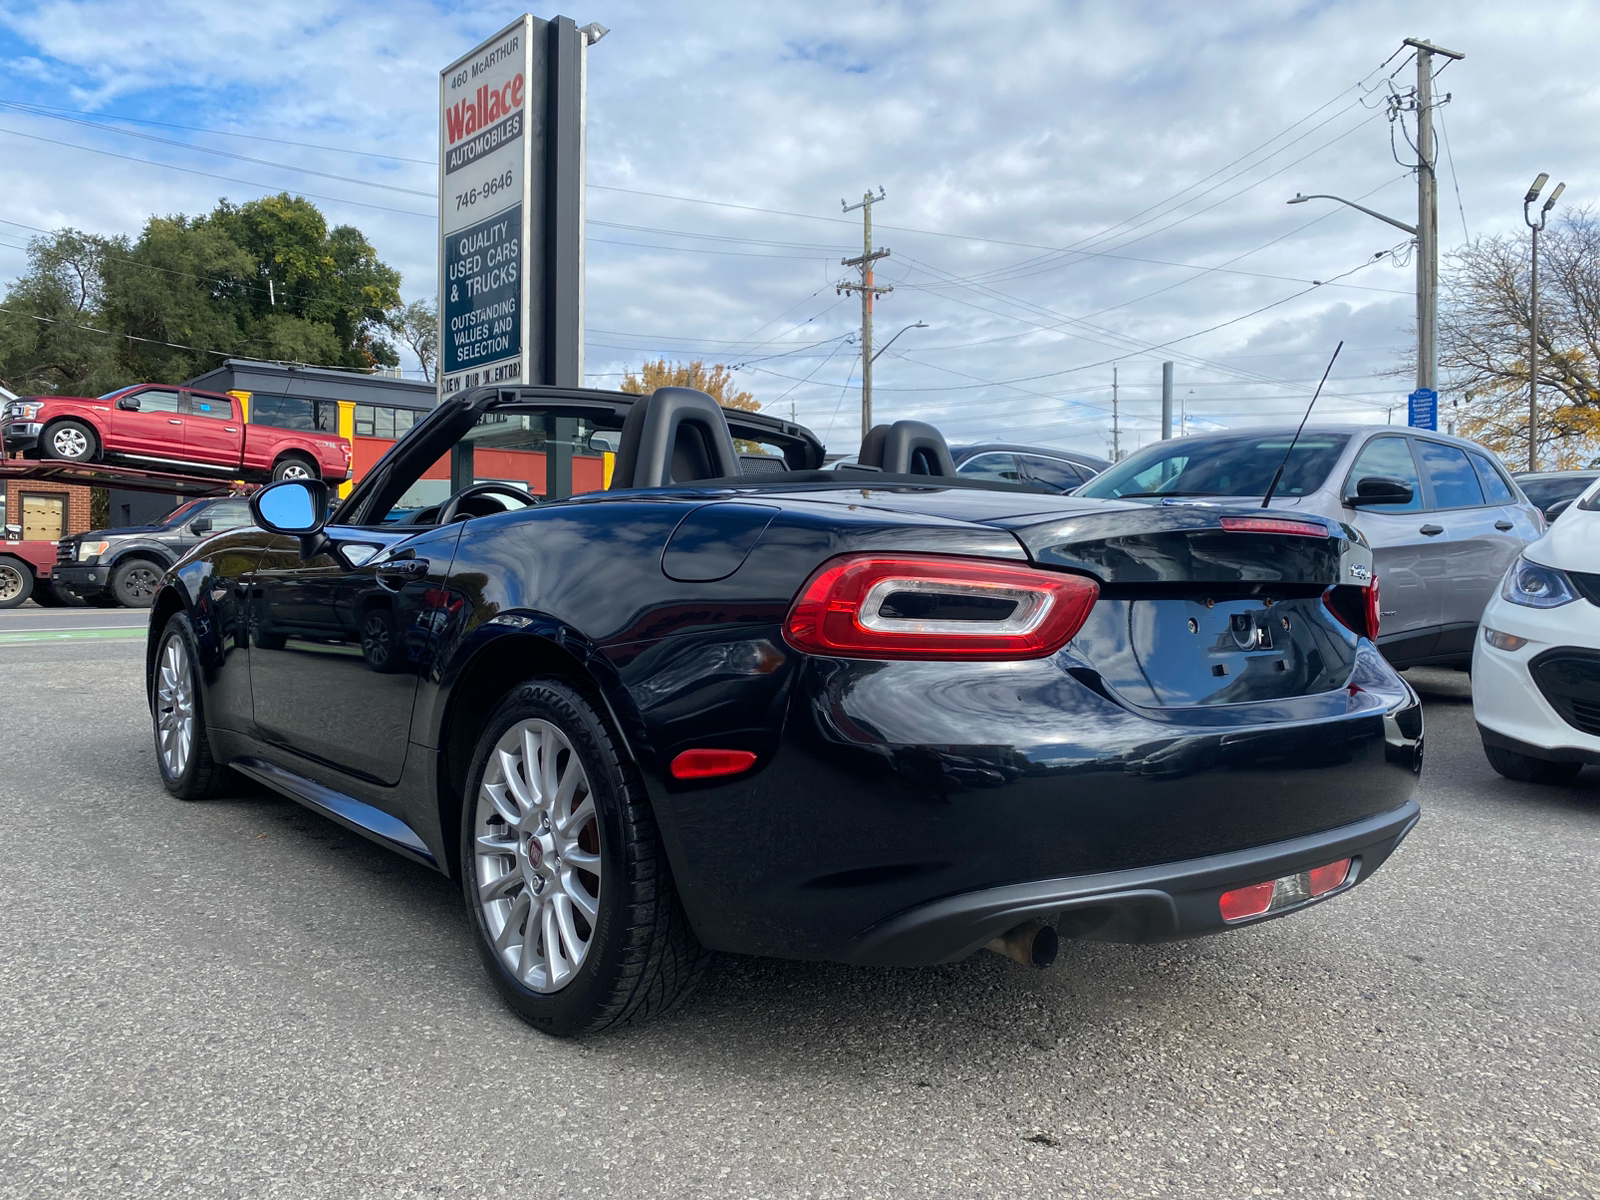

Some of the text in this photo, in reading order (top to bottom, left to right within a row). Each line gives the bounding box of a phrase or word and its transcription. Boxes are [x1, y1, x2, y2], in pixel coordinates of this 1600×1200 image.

[451, 36, 519, 90] 460 McARTHUR
[445, 72, 524, 145] Wallace
[450, 116, 520, 169] AUTOMOBILES
[455, 170, 513, 211] 746-9646
[460, 220, 508, 256] QUALITY
[449, 238, 518, 281] USED CARS
[450, 261, 517, 302] & TRUCKS
[451, 298, 516, 331] OUTSTANDING
[454, 316, 513, 346] VALUES AND
[457, 334, 509, 362] SELECTION
[466, 373, 479, 388] OUR
[483, 362, 521, 384] INENTORY
